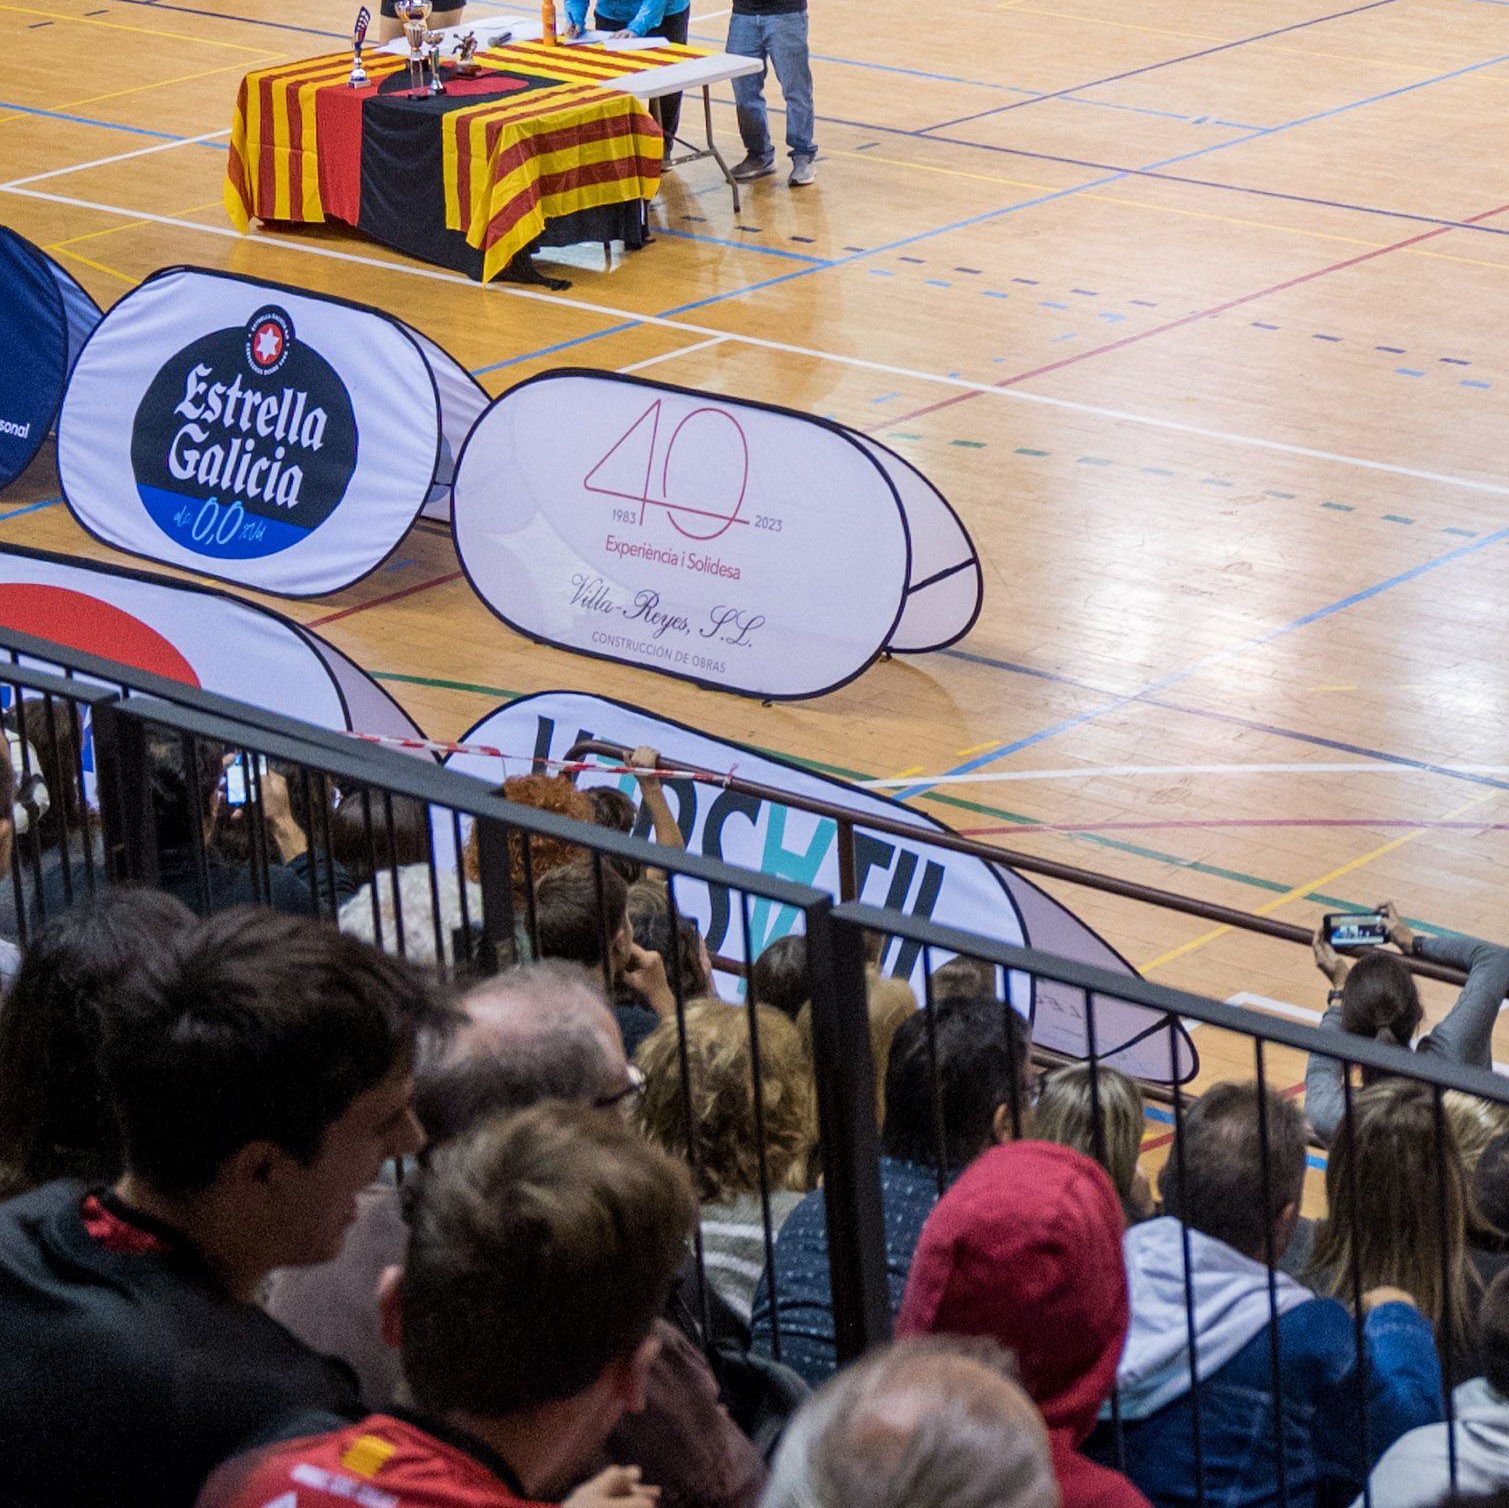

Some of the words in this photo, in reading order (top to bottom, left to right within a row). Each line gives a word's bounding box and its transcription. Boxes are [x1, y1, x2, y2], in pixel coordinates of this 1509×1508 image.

[174, 363, 327, 452] Estrella
[168, 423, 303, 509] Galicia
[584, 398, 749, 541] 40
[612, 508, 637, 525] 1983
[754, 514, 783, 532] 2023
[605, 534, 678, 567] Experiència
[680, 553, 686, 568] i
[686, 552, 741, 580] Solidesa
[674, 649, 690, 664] DE
[691, 654, 727, 674] OBRAS
